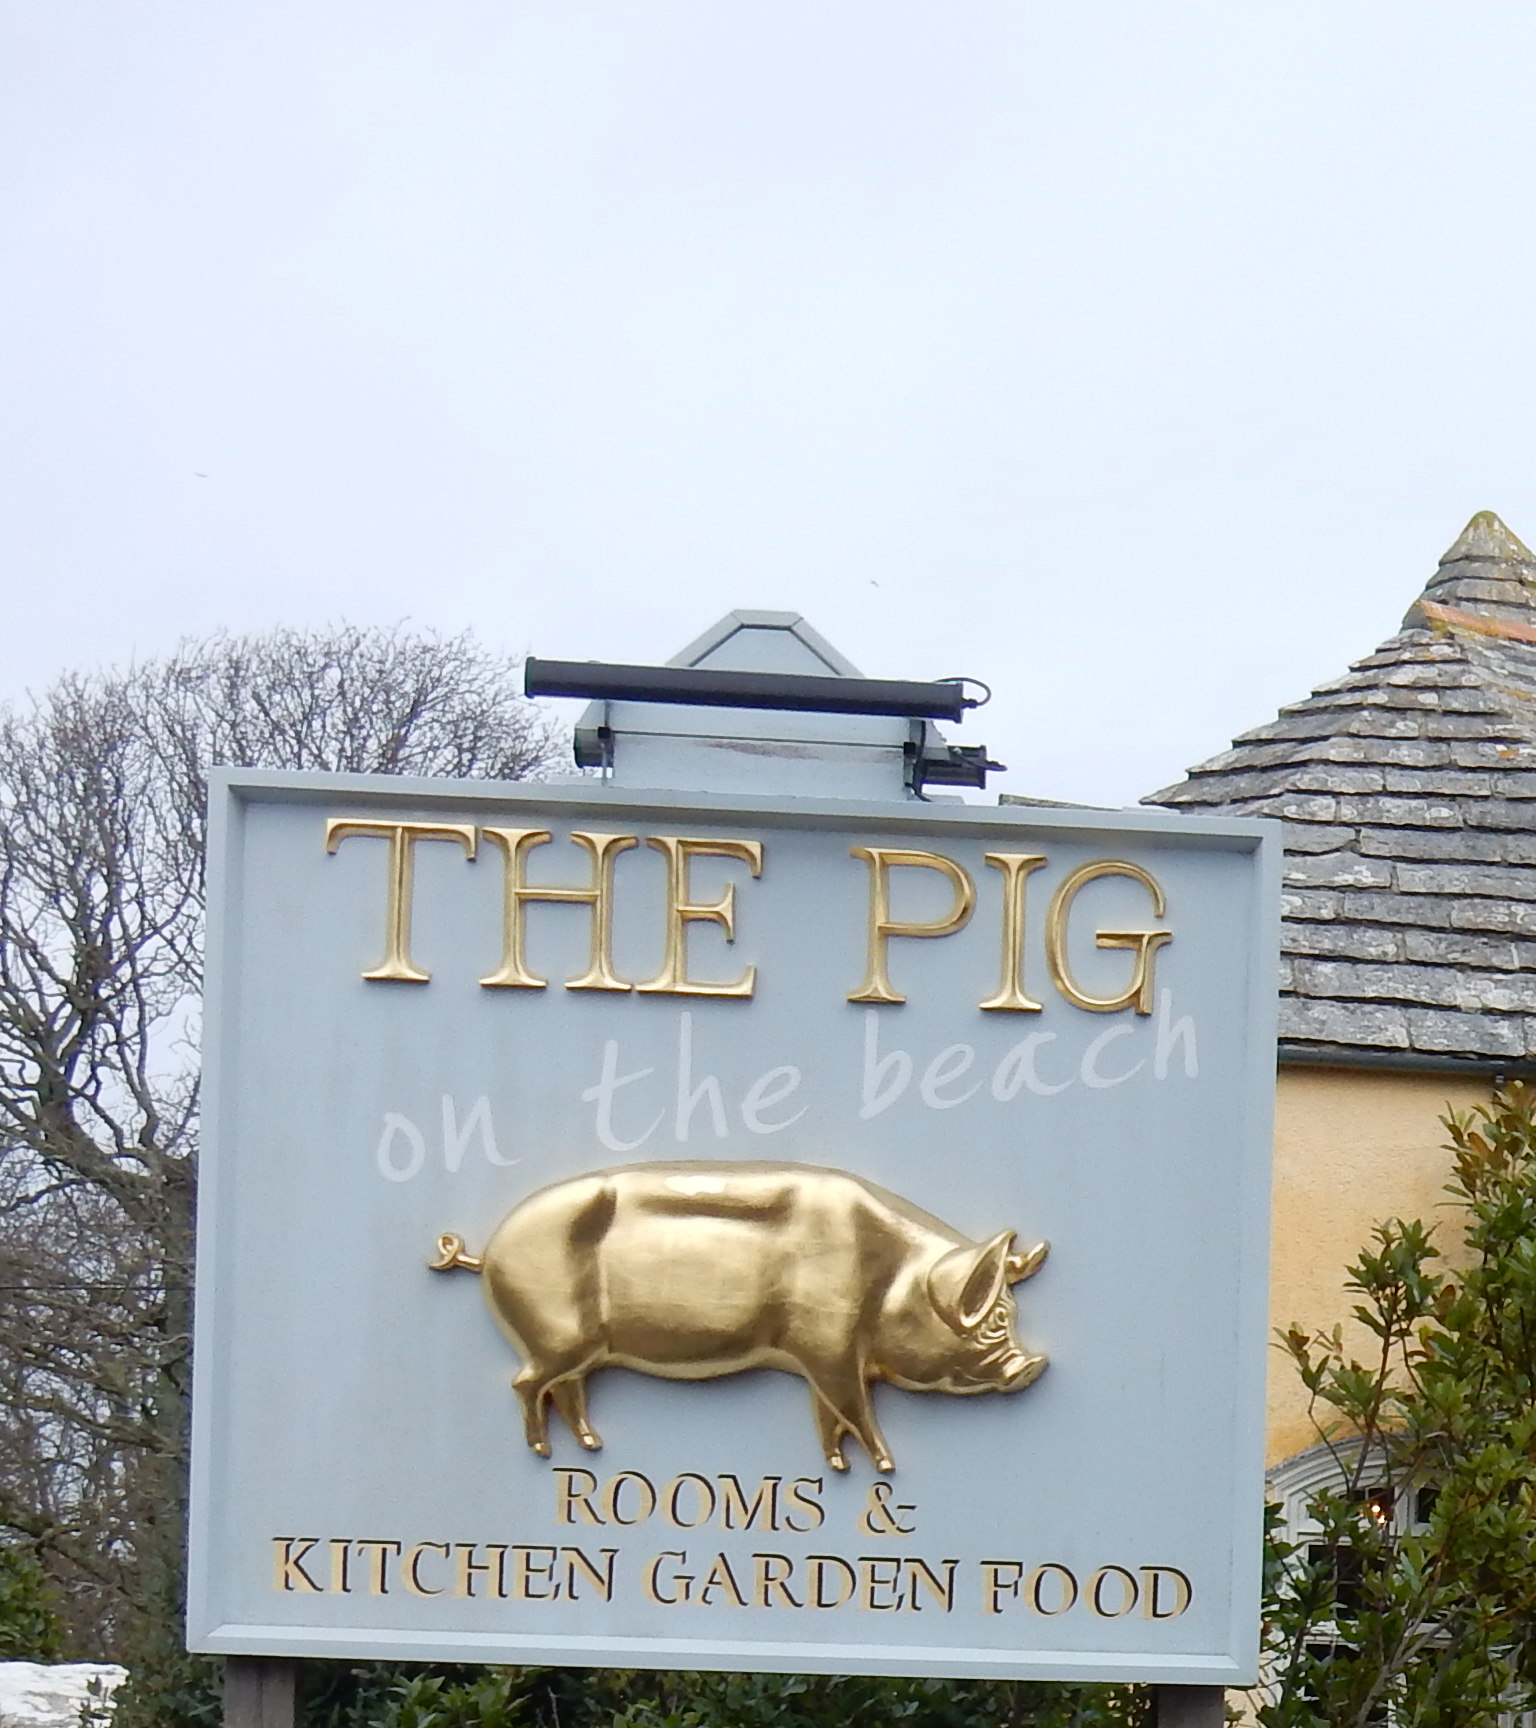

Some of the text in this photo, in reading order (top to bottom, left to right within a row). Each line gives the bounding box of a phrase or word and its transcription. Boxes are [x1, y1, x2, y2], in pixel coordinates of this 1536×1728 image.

[326, 817, 1173, 1016] THE PIG
[377, 987, 1199, 1182] on the beach
[552, 1467, 918, 1537] ROOMS &
[270, 1535, 1194, 1622] KITCHEN GARDEN FOOD
